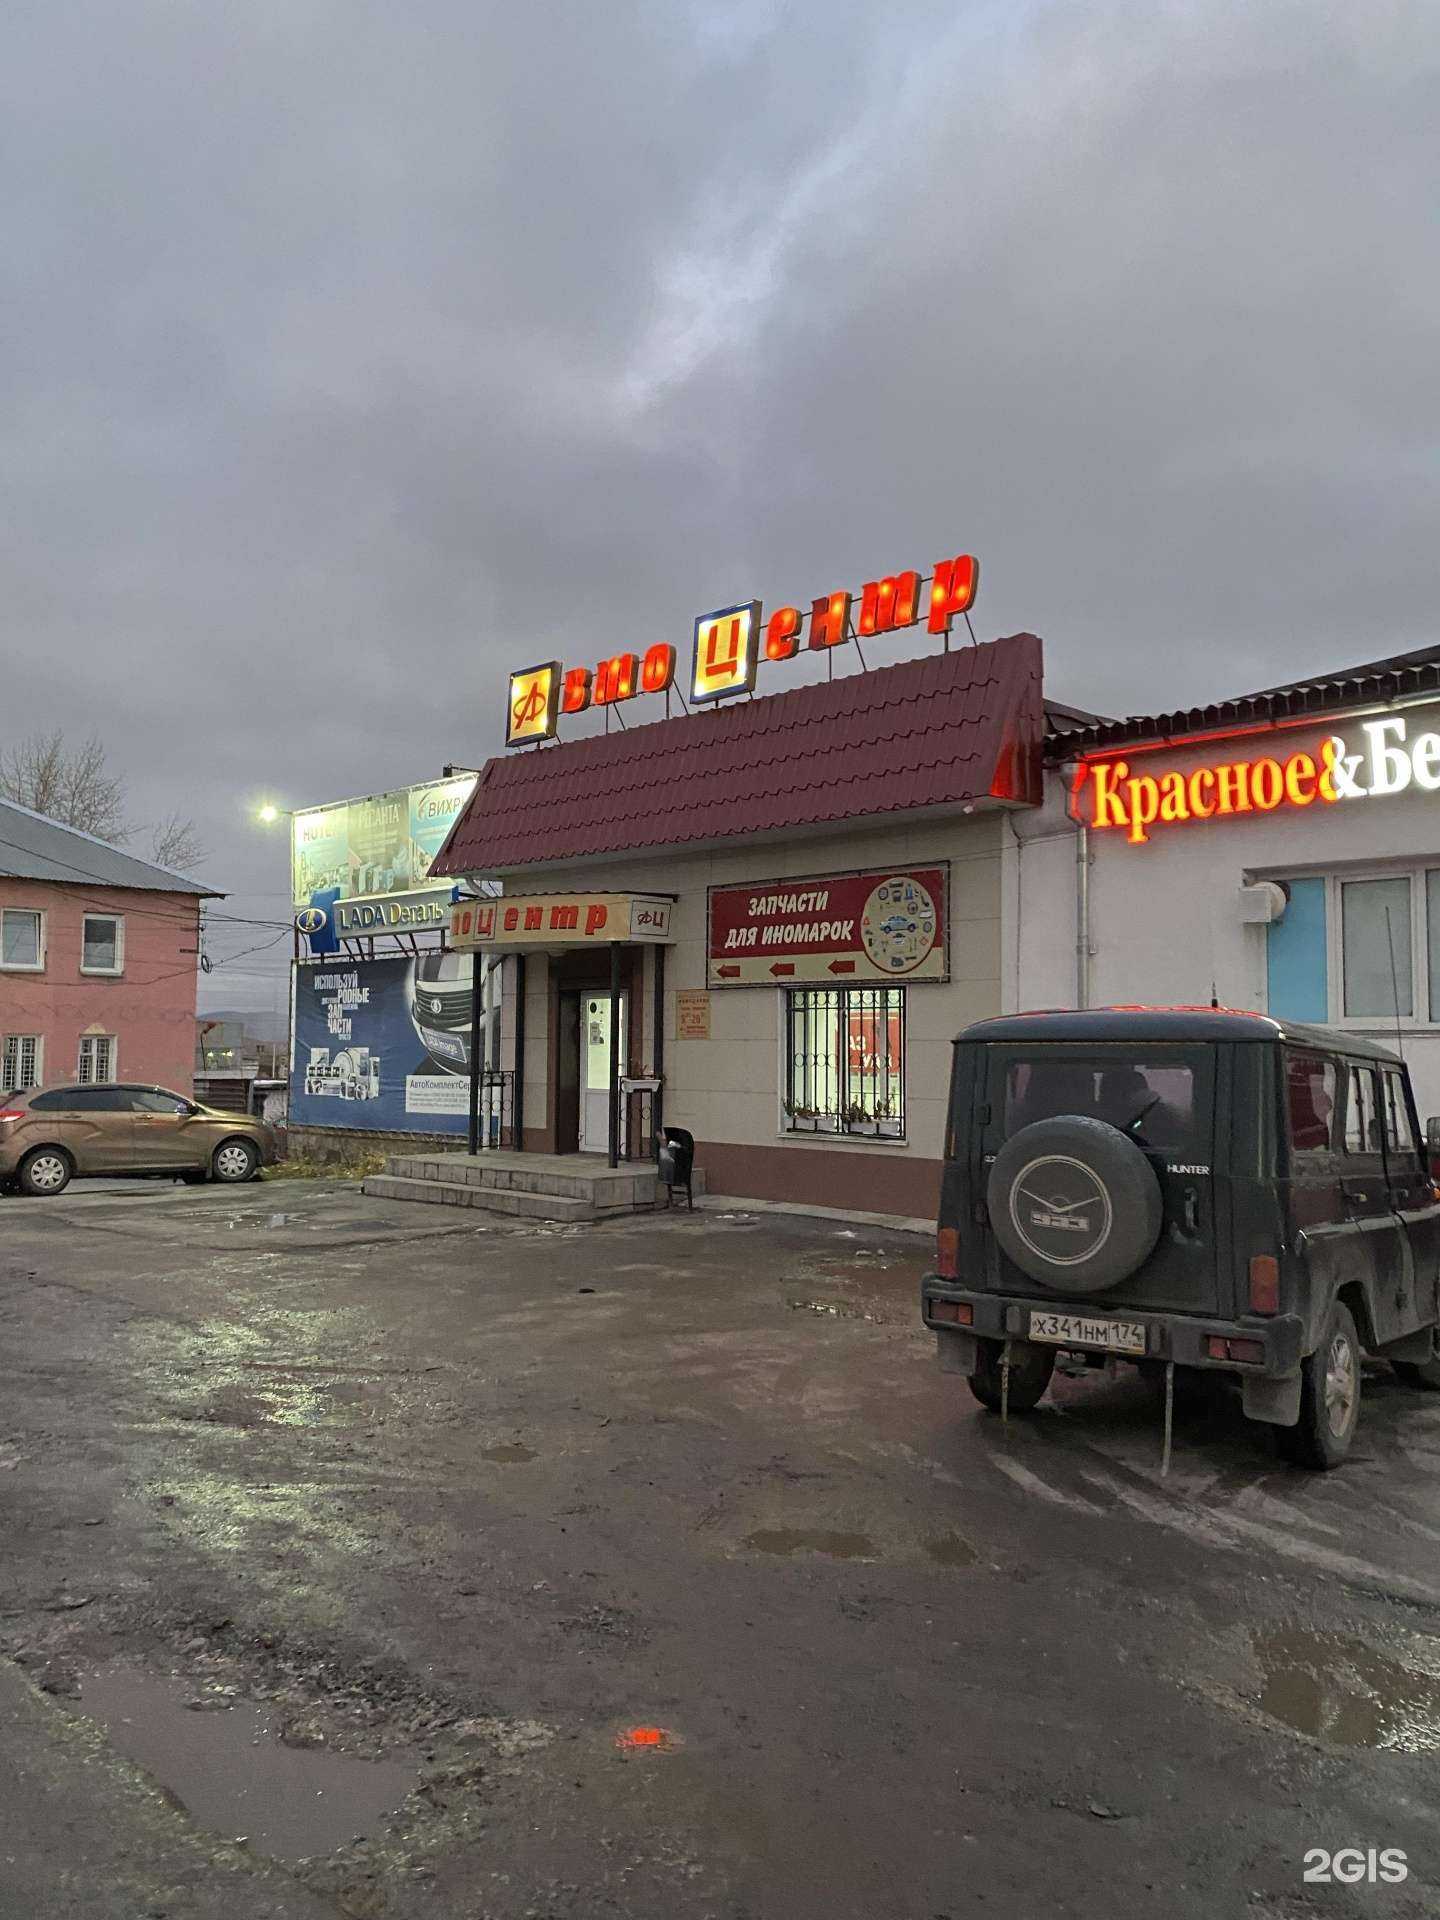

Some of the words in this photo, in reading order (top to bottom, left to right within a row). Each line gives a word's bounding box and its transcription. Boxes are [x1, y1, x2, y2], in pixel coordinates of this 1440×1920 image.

[428, 796, 465, 818] ВИХР
[749, 890, 829, 916] ЗАПЧАСТИ
[341, 904, 387, 929] LADA
[725, 926, 757, 949] ДЛЯ
[761, 920, 854, 945] ИНОМАРОК
[314, 970, 358, 990] ИСПОЛЬЗУЙ
[337, 987, 370, 1003] РОДНЫЕ
[327, 1003, 343, 1019] ЗАП
[327, 1018, 352, 1034] ЧАСТИ
[1166, 1163, 1210, 1176] HUNTER
